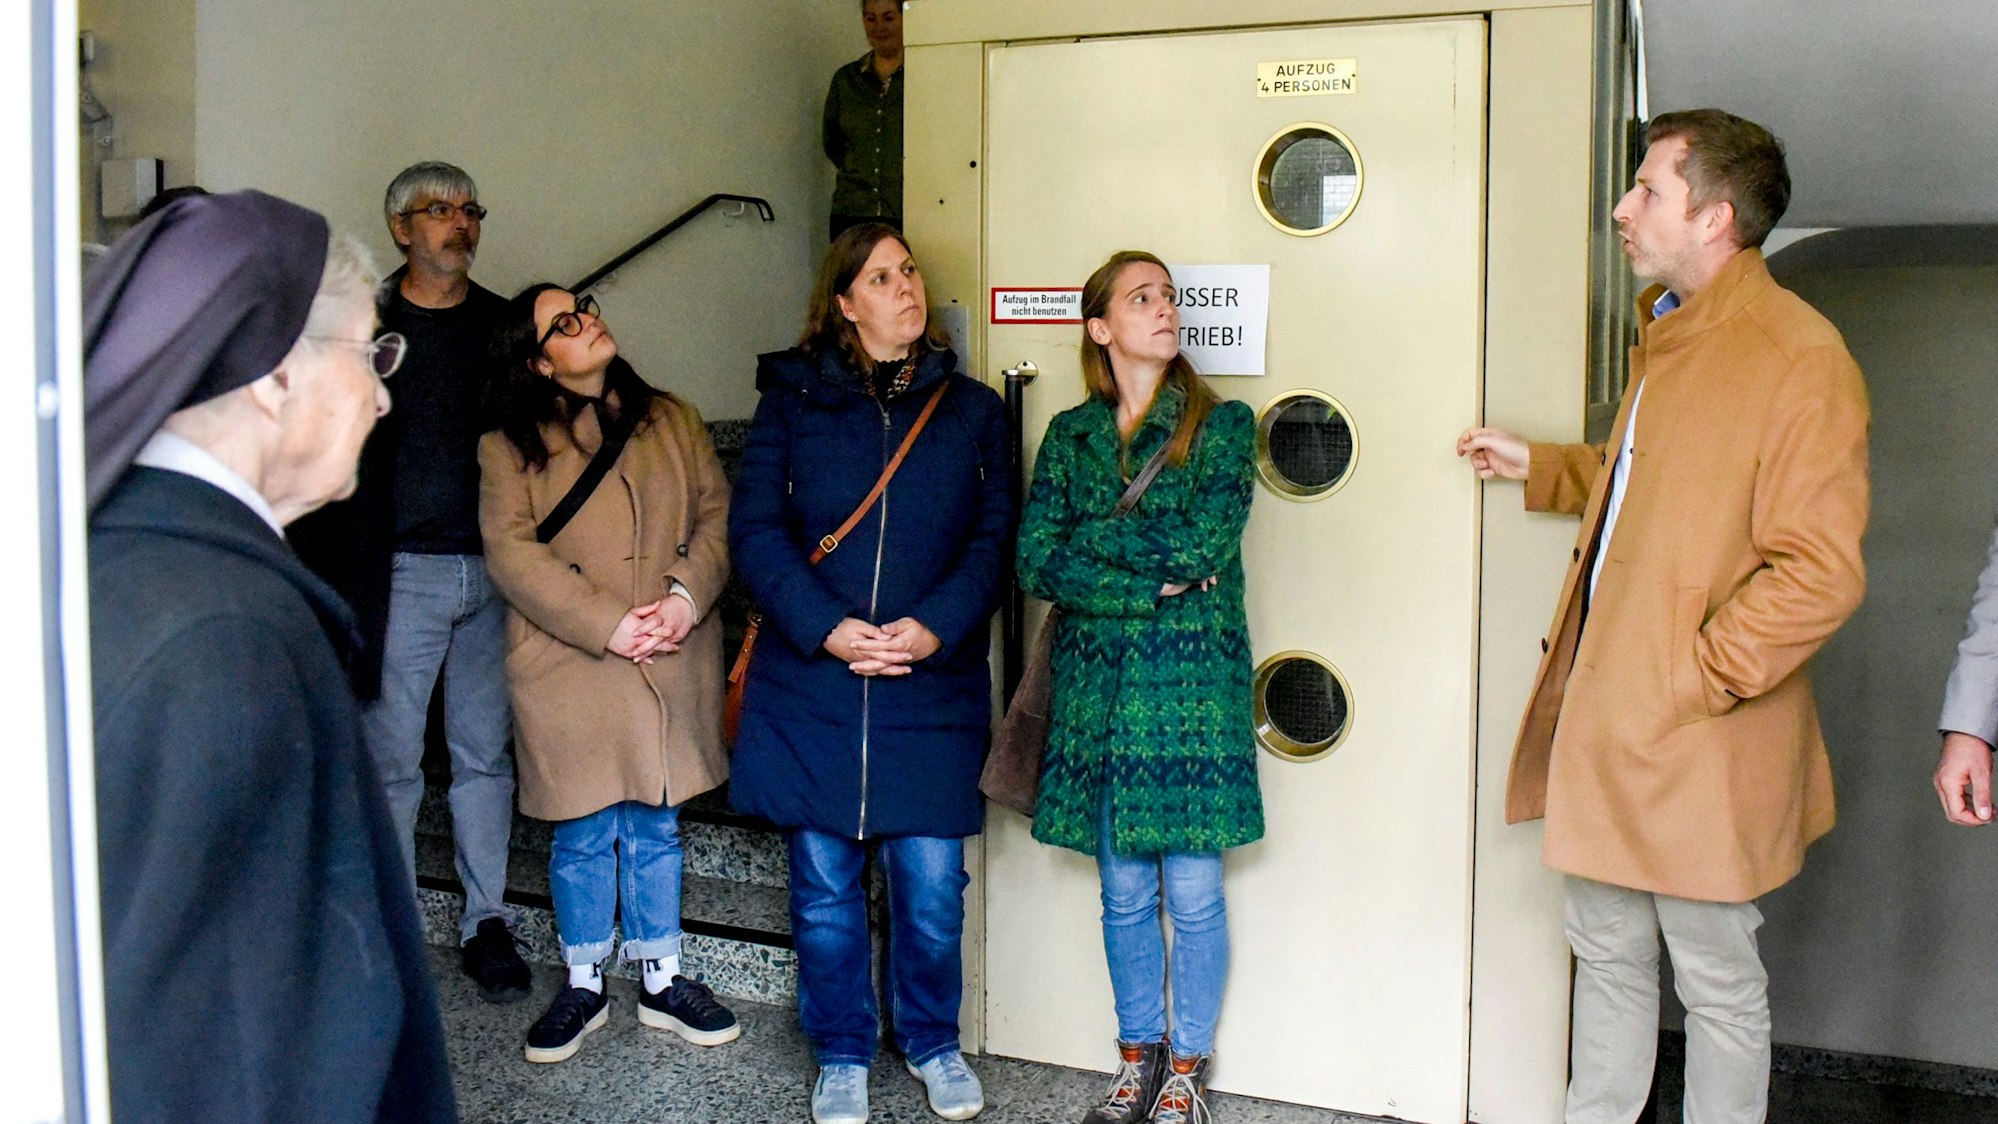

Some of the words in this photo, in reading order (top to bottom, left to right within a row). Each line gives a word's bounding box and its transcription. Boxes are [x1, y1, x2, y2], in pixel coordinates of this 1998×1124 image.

[1276, 63, 1336, 76] AUFZUG
[1261, 82, 1270, 93] 4
[1274, 78, 1351, 93] PERSONEN
[1002, 294, 1029, 306] Aufzug
[1029, 294, 1040, 304] im
[1041, 294, 1077, 304] Brandfall
[1011, 306, 1031, 316] nicht
[1032, 306, 1067, 316] benutzen
